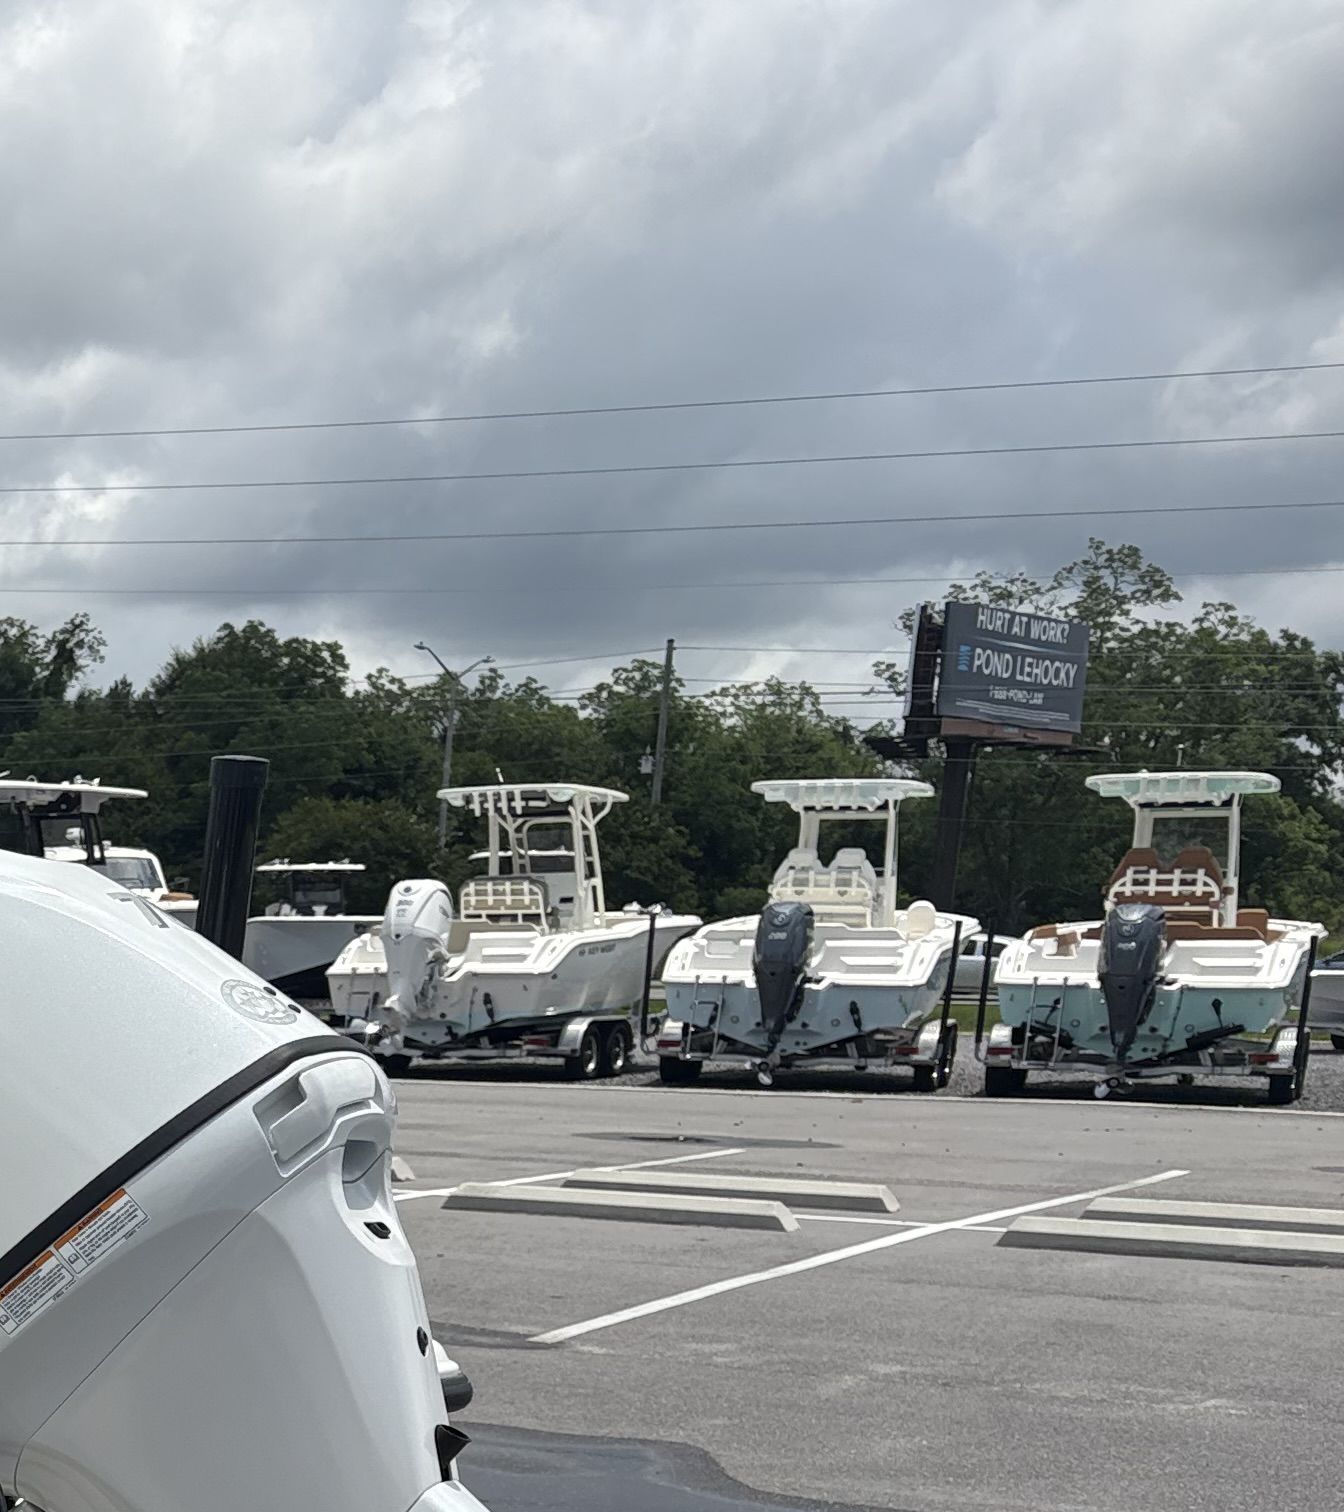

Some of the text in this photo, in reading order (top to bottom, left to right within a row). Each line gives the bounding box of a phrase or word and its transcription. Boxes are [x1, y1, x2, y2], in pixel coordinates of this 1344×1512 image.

[976, 607, 1070, 644] HURT AT WORK?
[972, 647, 1078, 689] POND LEHOCKY
